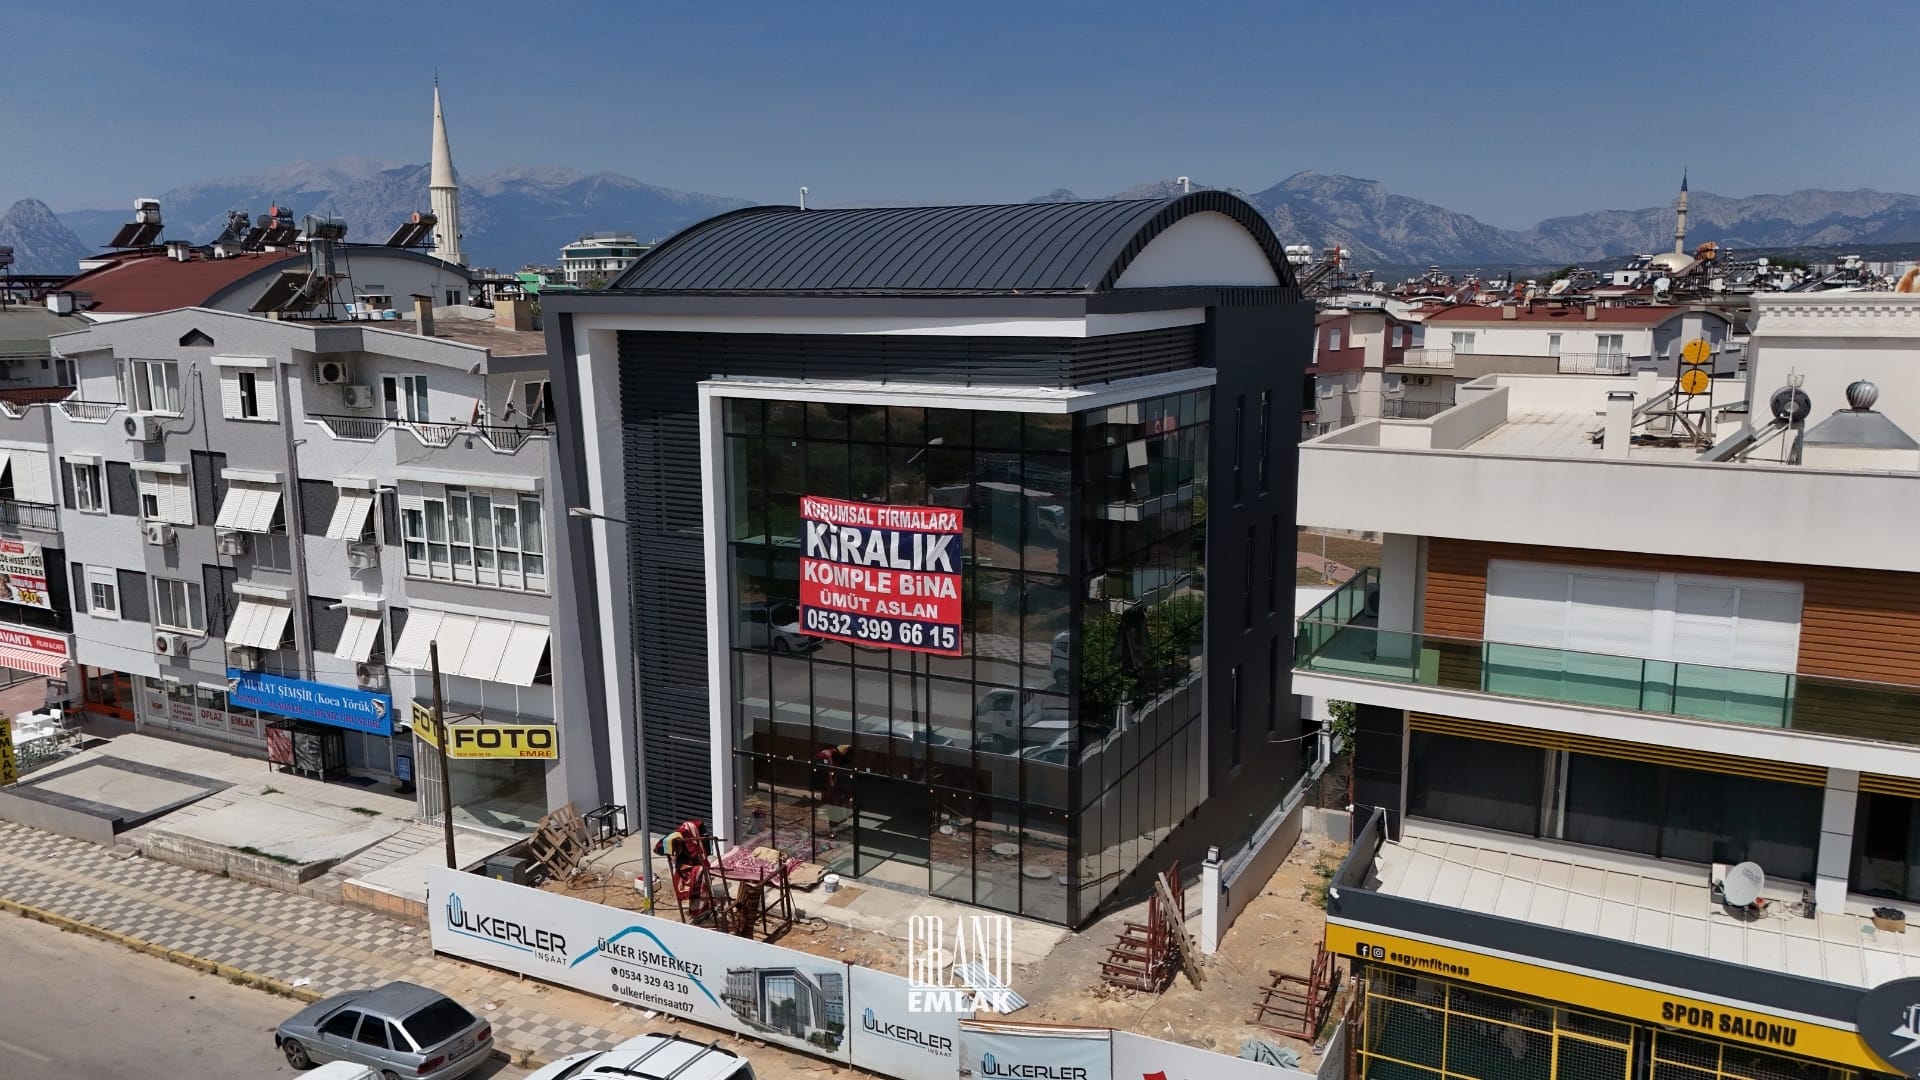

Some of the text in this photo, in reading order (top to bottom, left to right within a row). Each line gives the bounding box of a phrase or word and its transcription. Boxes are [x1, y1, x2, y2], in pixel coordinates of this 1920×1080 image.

[804, 500, 873, 526] KURUMSAL
[7, 566, 43, 576] LEZZETLER
[804, 561, 892, 594] KOMPLE
[820, 589, 938, 619] ÜMÜT ASLAN
[808, 609, 955, 648] 0532 399 66 15
[242, 679, 276, 695] MURAT
[314, 692, 340, 708] (Koca
[342, 697, 374, 714] Yörük)
[200, 709, 223, 722] OFLAZ
[230, 716, 255, 728] EMLAK
[455, 729, 552, 749] FOTO
[597, 937, 635, 960] ÜLKER
[1390, 950, 1470, 976] esgymfitness
[619, 968, 689, 994] 0534 329 43 10
[620, 984, 694, 1013] ulkerlerinsaat07
[1662, 1001, 1797, 1046] SPOR SALONU
